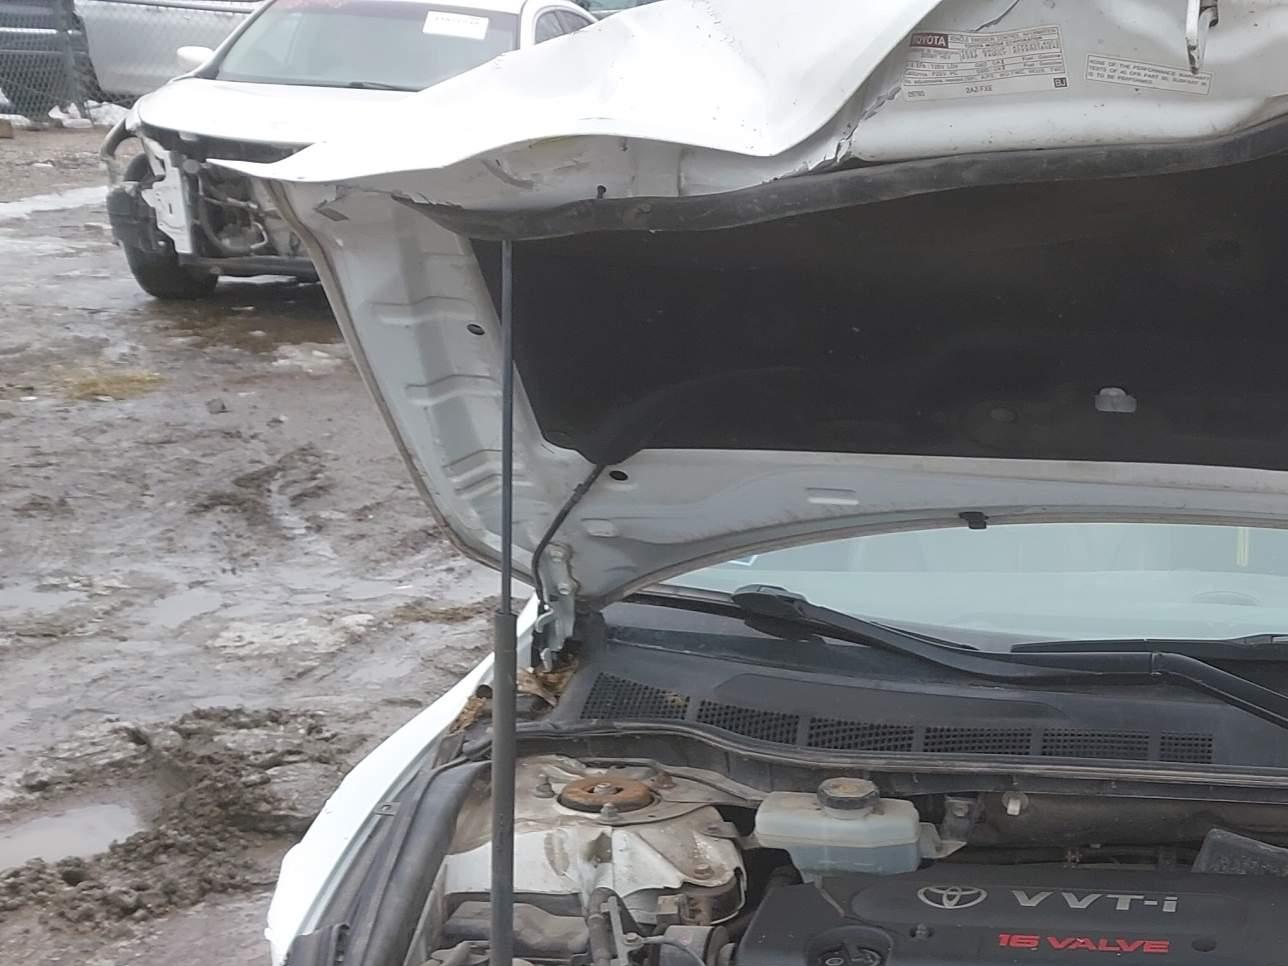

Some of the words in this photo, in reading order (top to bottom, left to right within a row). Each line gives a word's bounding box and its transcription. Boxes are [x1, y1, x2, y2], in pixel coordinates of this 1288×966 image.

[913, 35, 946, 47] OYOTA
[1012, 889, 1178, 913] VVT-i
[998, 933, 1041, 948] 16
[1046, 936, 1170, 953] VALVE
